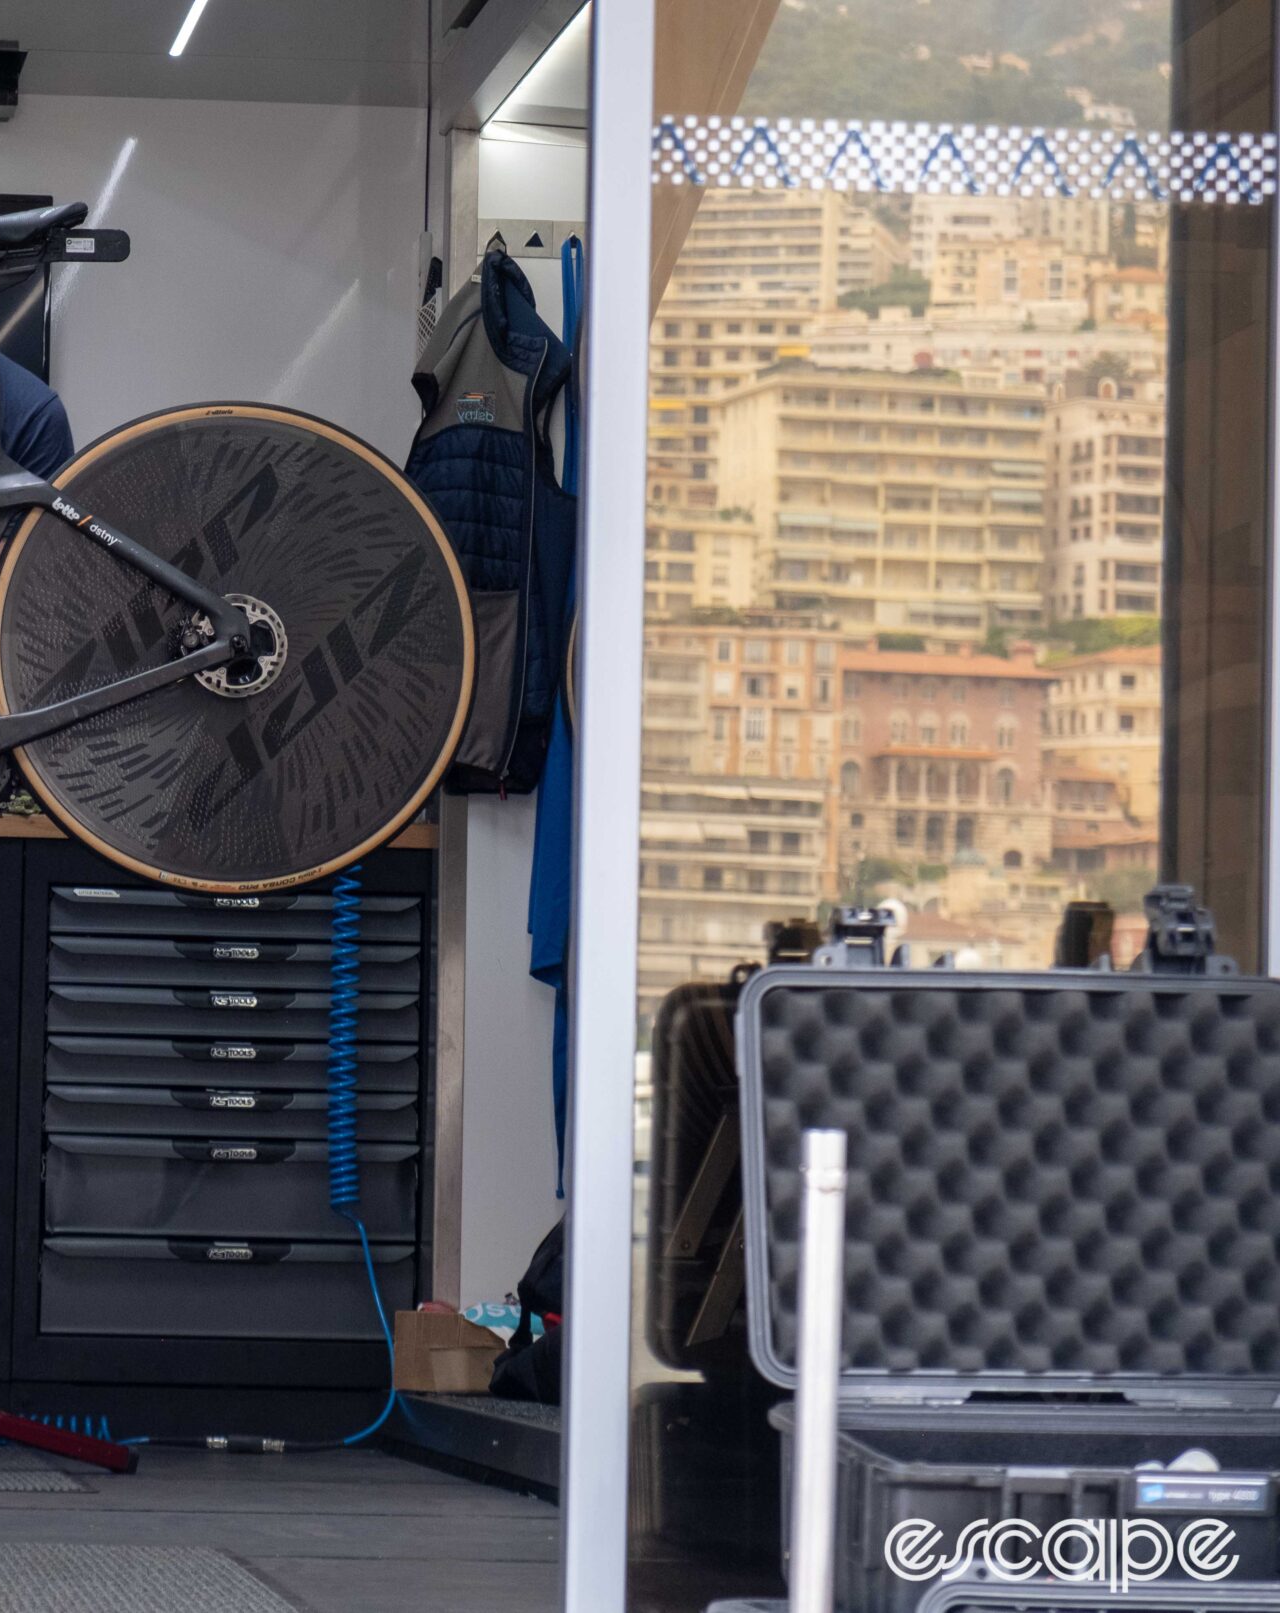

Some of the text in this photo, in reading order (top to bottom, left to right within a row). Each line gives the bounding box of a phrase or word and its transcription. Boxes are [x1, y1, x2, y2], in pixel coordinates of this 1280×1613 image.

[52, 497, 118, 546] lotto dstny
[232, 898, 257, 907] TOOLS
[231, 948, 256, 958] TOOLS
[229, 996, 255, 1006] TOOLS
[228, 1048, 254, 1058] TOOLS
[228, 1097, 253, 1107] TOOLS
[229, 1149, 254, 1159] TOOLS
